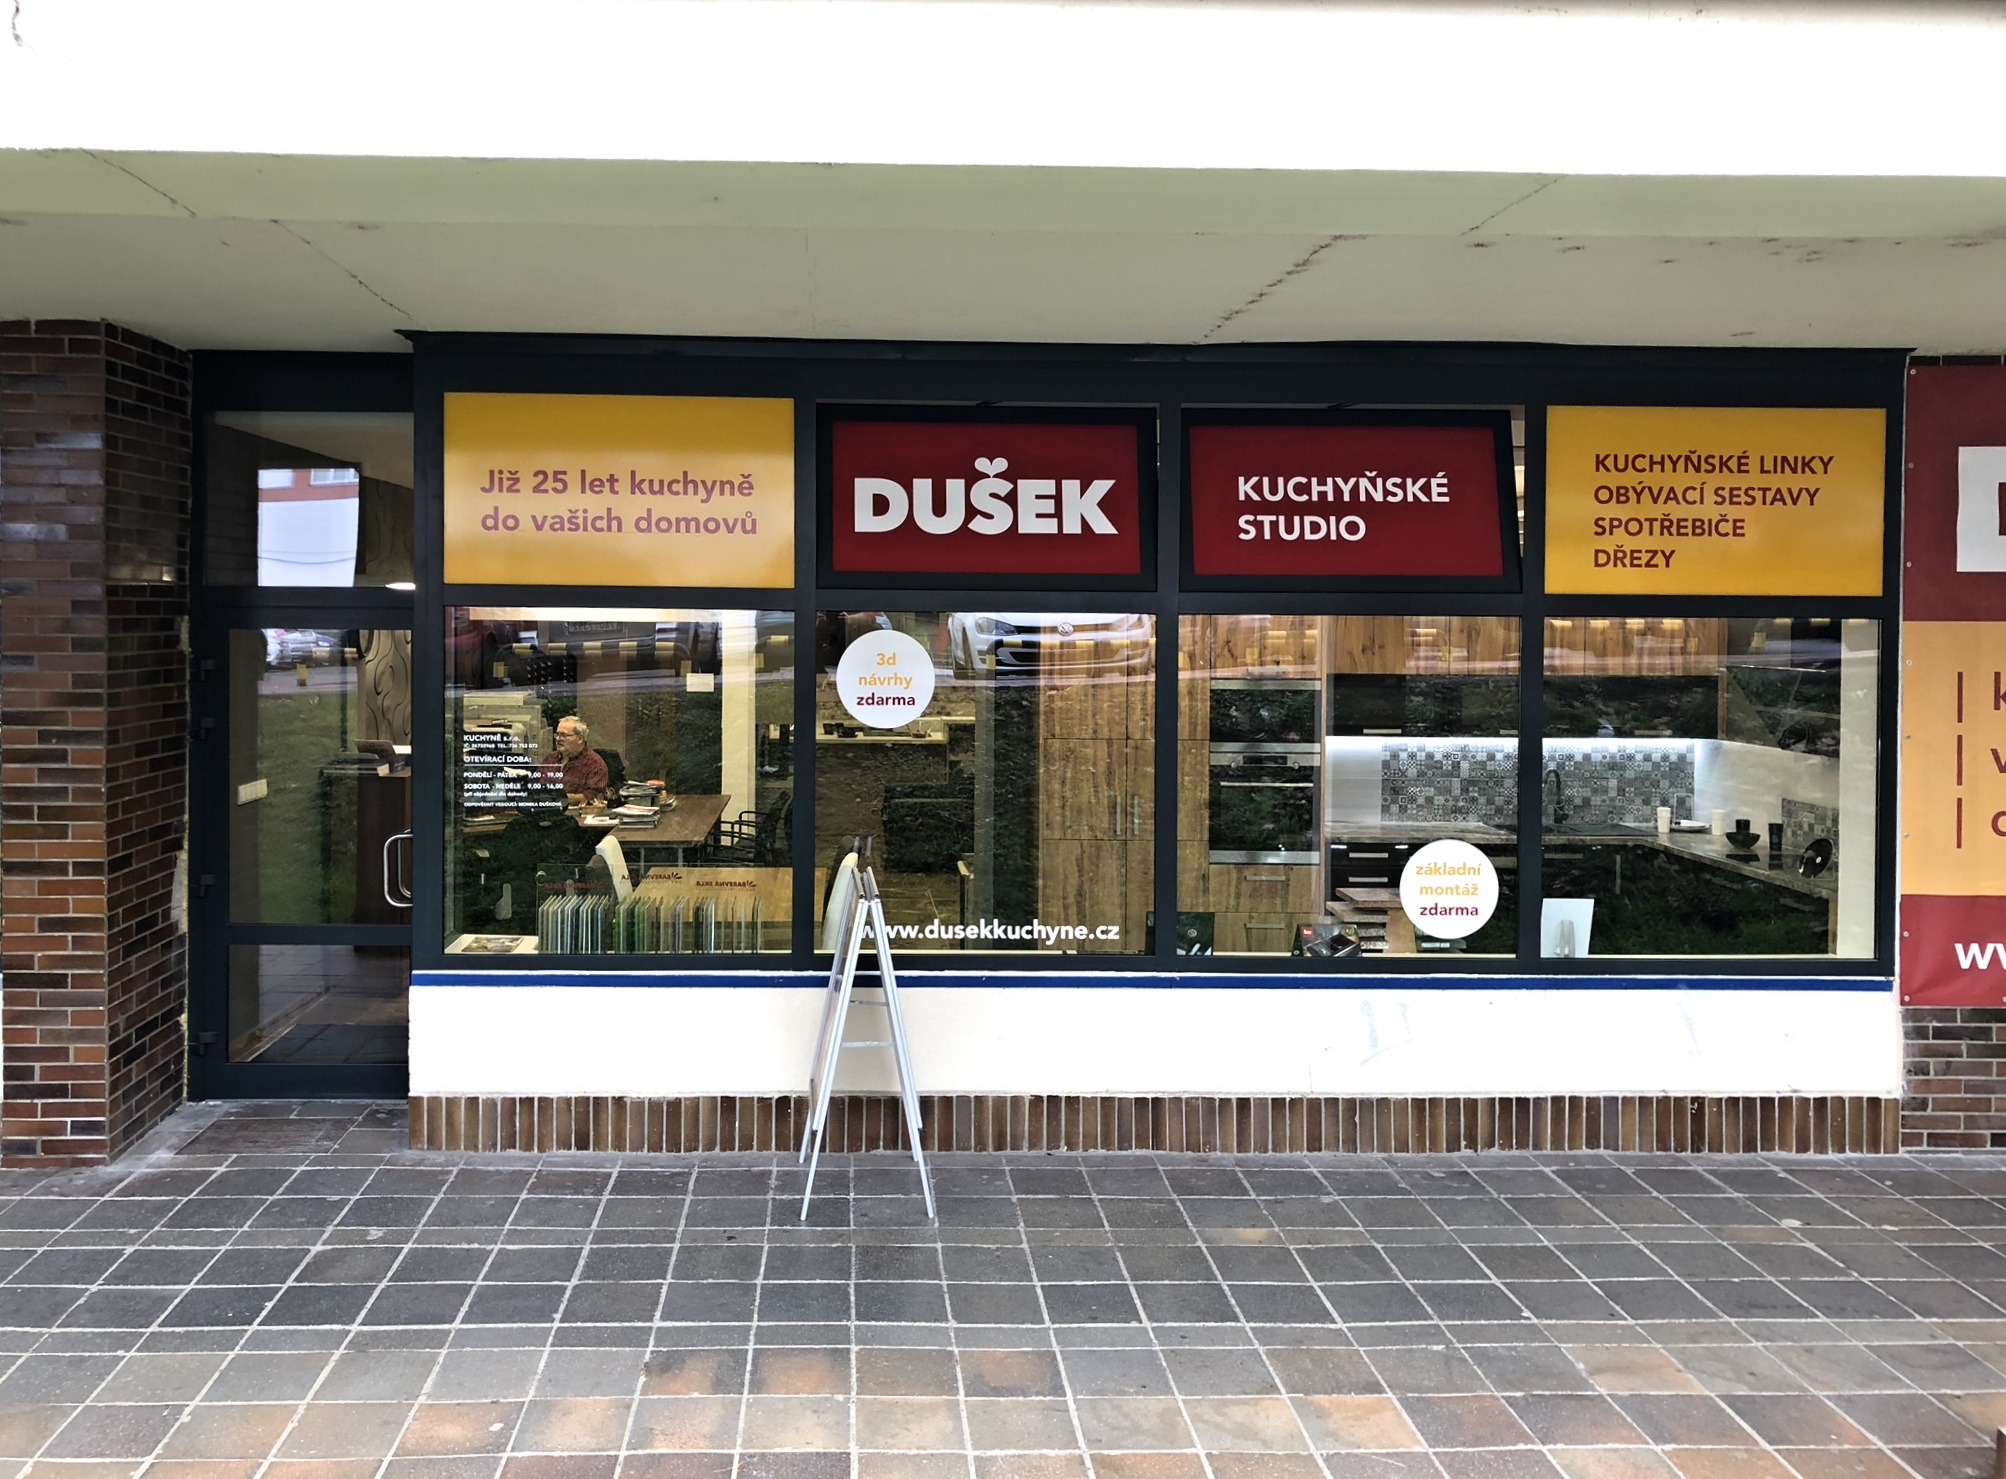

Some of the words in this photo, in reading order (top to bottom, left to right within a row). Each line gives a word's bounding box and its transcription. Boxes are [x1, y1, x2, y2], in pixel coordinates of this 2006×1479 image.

[1595, 450, 1750, 474] KUCHYŇSKÉ
[1759, 455, 1835, 475] LINKY
[480, 469, 520, 494] Již
[531, 470, 568, 494] 25
[580, 469, 619, 495] let
[629, 470, 755, 504] kuchyně
[854, 456, 1119, 535] DUŠEK
[1237, 471, 1450, 503] KUCHYŇSKÉ
[1593, 480, 1706, 505] OBÝVACÍ
[1713, 486, 1821, 506] SESTAVY
[480, 505, 520, 532] do
[530, 507, 623, 533] vašich
[633, 507, 758, 535] domovů
[1238, 514, 1366, 541] STUDIO
[1593, 513, 1746, 538] SPOTŘEBIČE
[1594, 544, 1676, 569] DŘEZY
[876, 652, 897, 666] 3d
[858, 672, 913, 690] návrhy
[856, 692, 916, 706] zdarma
[463, 733, 501, 742] KUCHYNĚ
[463, 755, 505, 763] OTEVÍRACÍ
[495, 782, 521, 790] NEDĚLE
[1415, 862, 1482, 876] základní
[1419, 883, 1479, 896] montáž
[1419, 902, 1479, 916] zdarma
